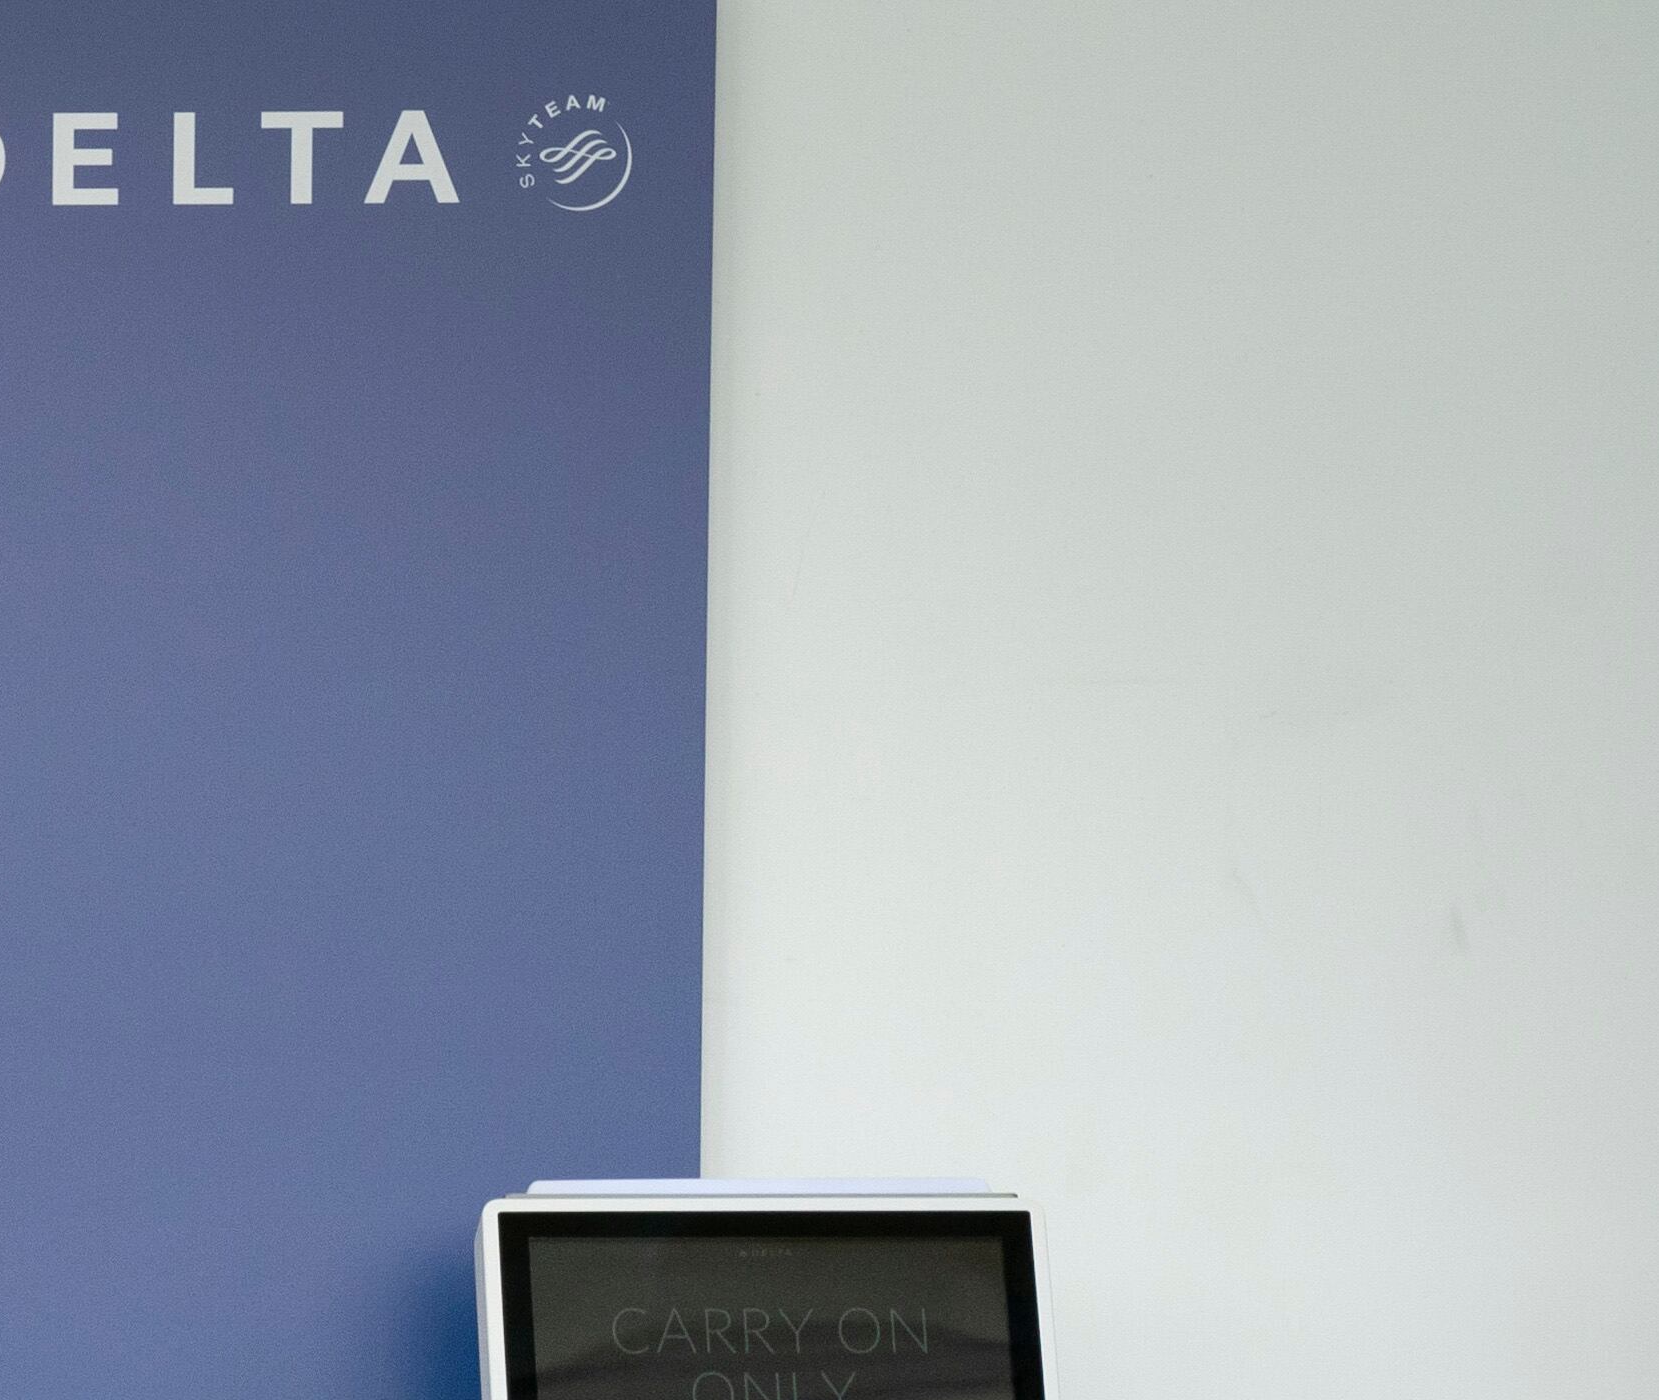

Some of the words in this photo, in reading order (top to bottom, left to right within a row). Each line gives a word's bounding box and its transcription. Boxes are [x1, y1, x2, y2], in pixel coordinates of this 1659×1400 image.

[515, 94, 606, 188] SKYTEAM
[611, 1306, 814, 1355] CARRY
[837, 1306, 929, 1355] ON
